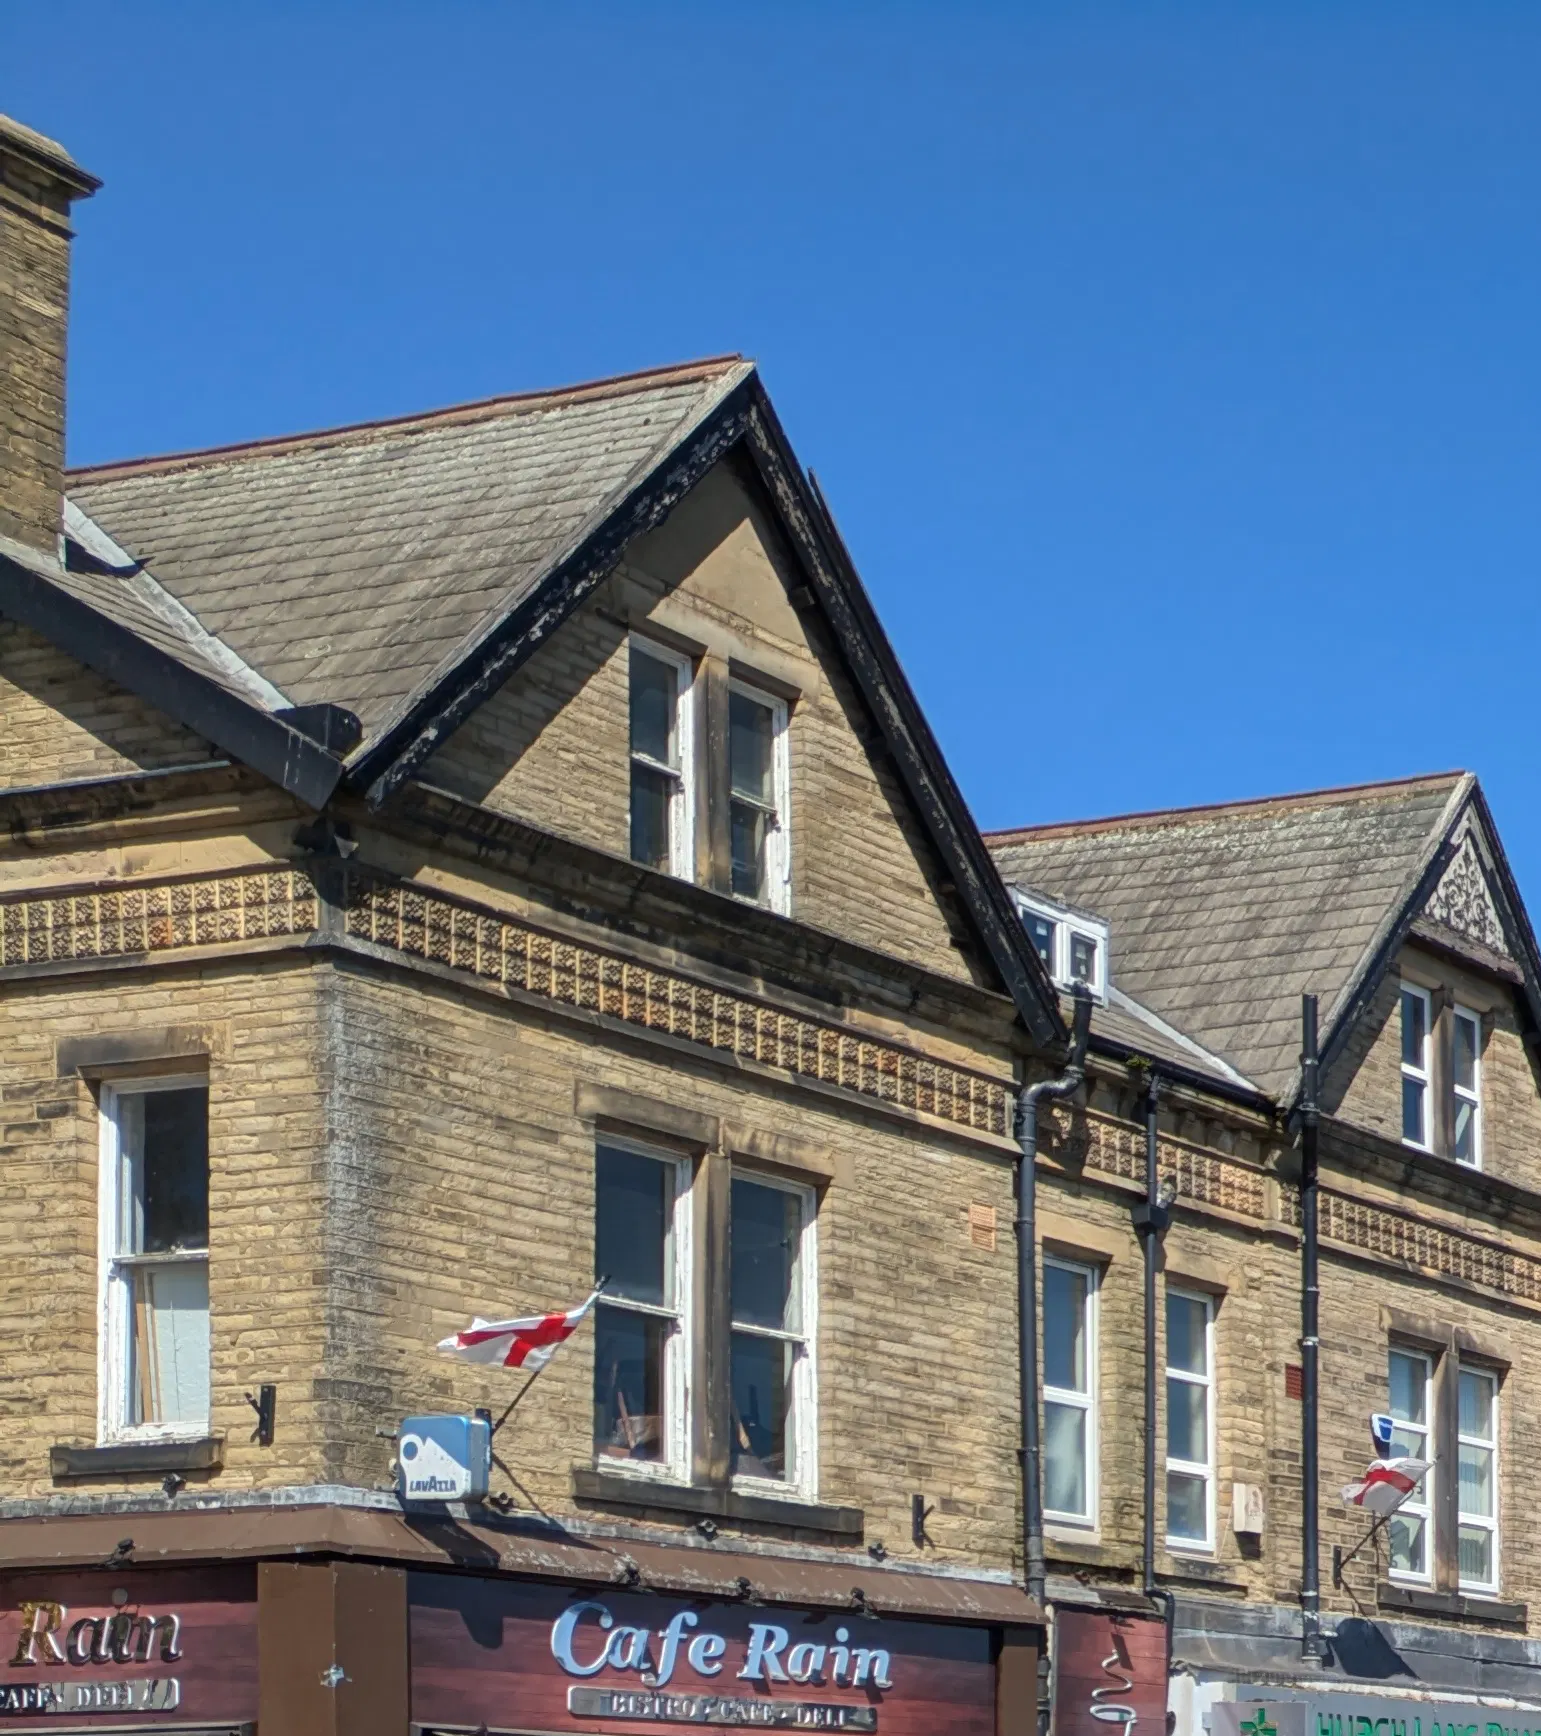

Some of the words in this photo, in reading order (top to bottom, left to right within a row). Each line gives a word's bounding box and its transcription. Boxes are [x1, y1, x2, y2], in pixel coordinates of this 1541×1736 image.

[409, 1475, 457, 1493] LAVAZZA
[9, 1587, 183, 1667] Rain
[551, 1600, 727, 1687] Cafe
[736, 1623, 893, 1689] Rain
[612, 1694, 696, 1717] BISTRO
[797, 1707, 846, 1727] DELI
